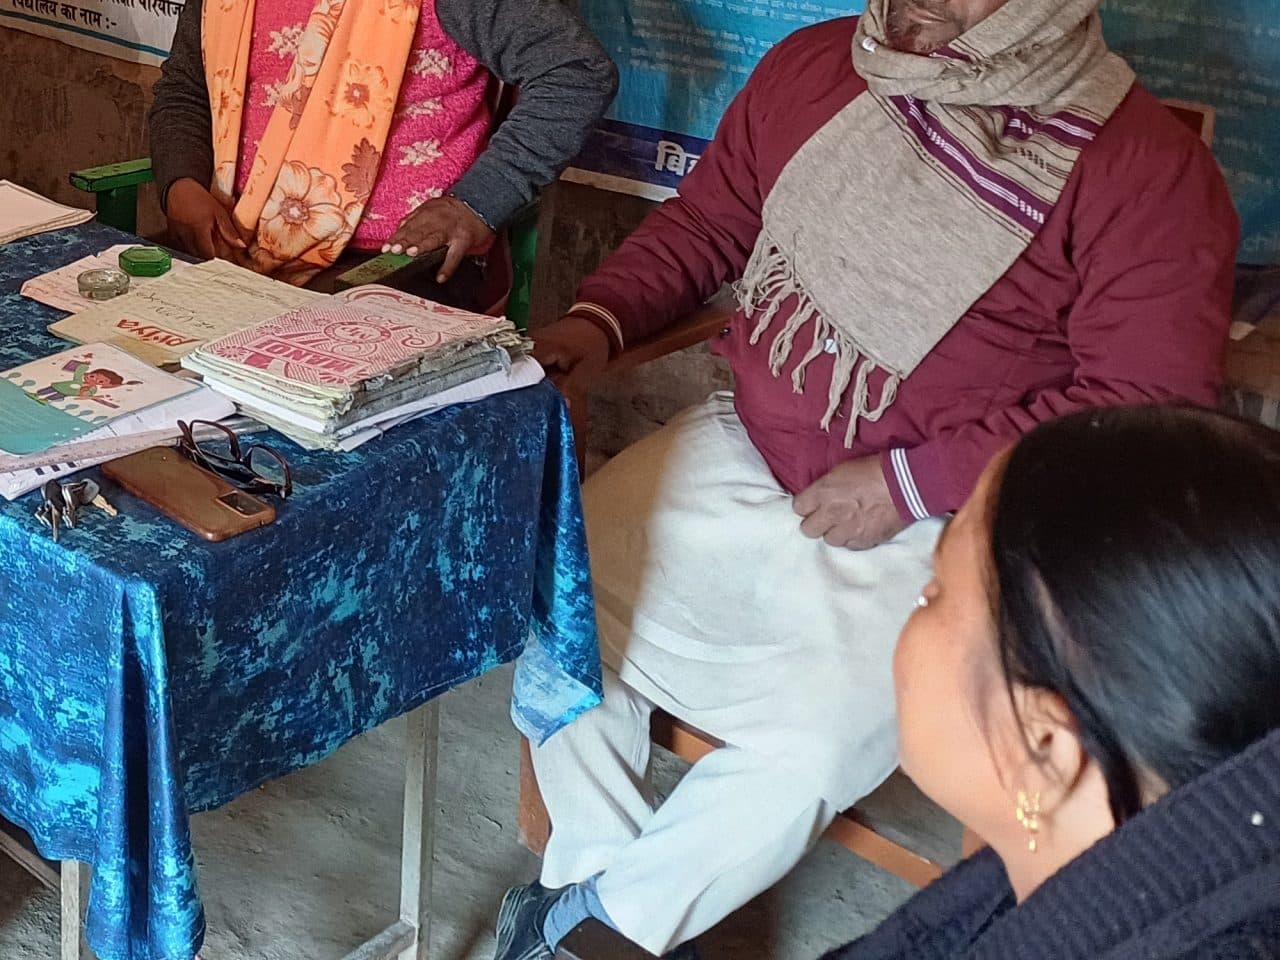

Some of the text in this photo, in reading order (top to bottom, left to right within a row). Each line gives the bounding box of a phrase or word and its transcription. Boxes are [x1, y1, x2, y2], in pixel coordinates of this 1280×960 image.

[61, 5, 77, 21] का
[79, 8, 102, 28] नाम
[253, 339, 355, 372] MANOJ
